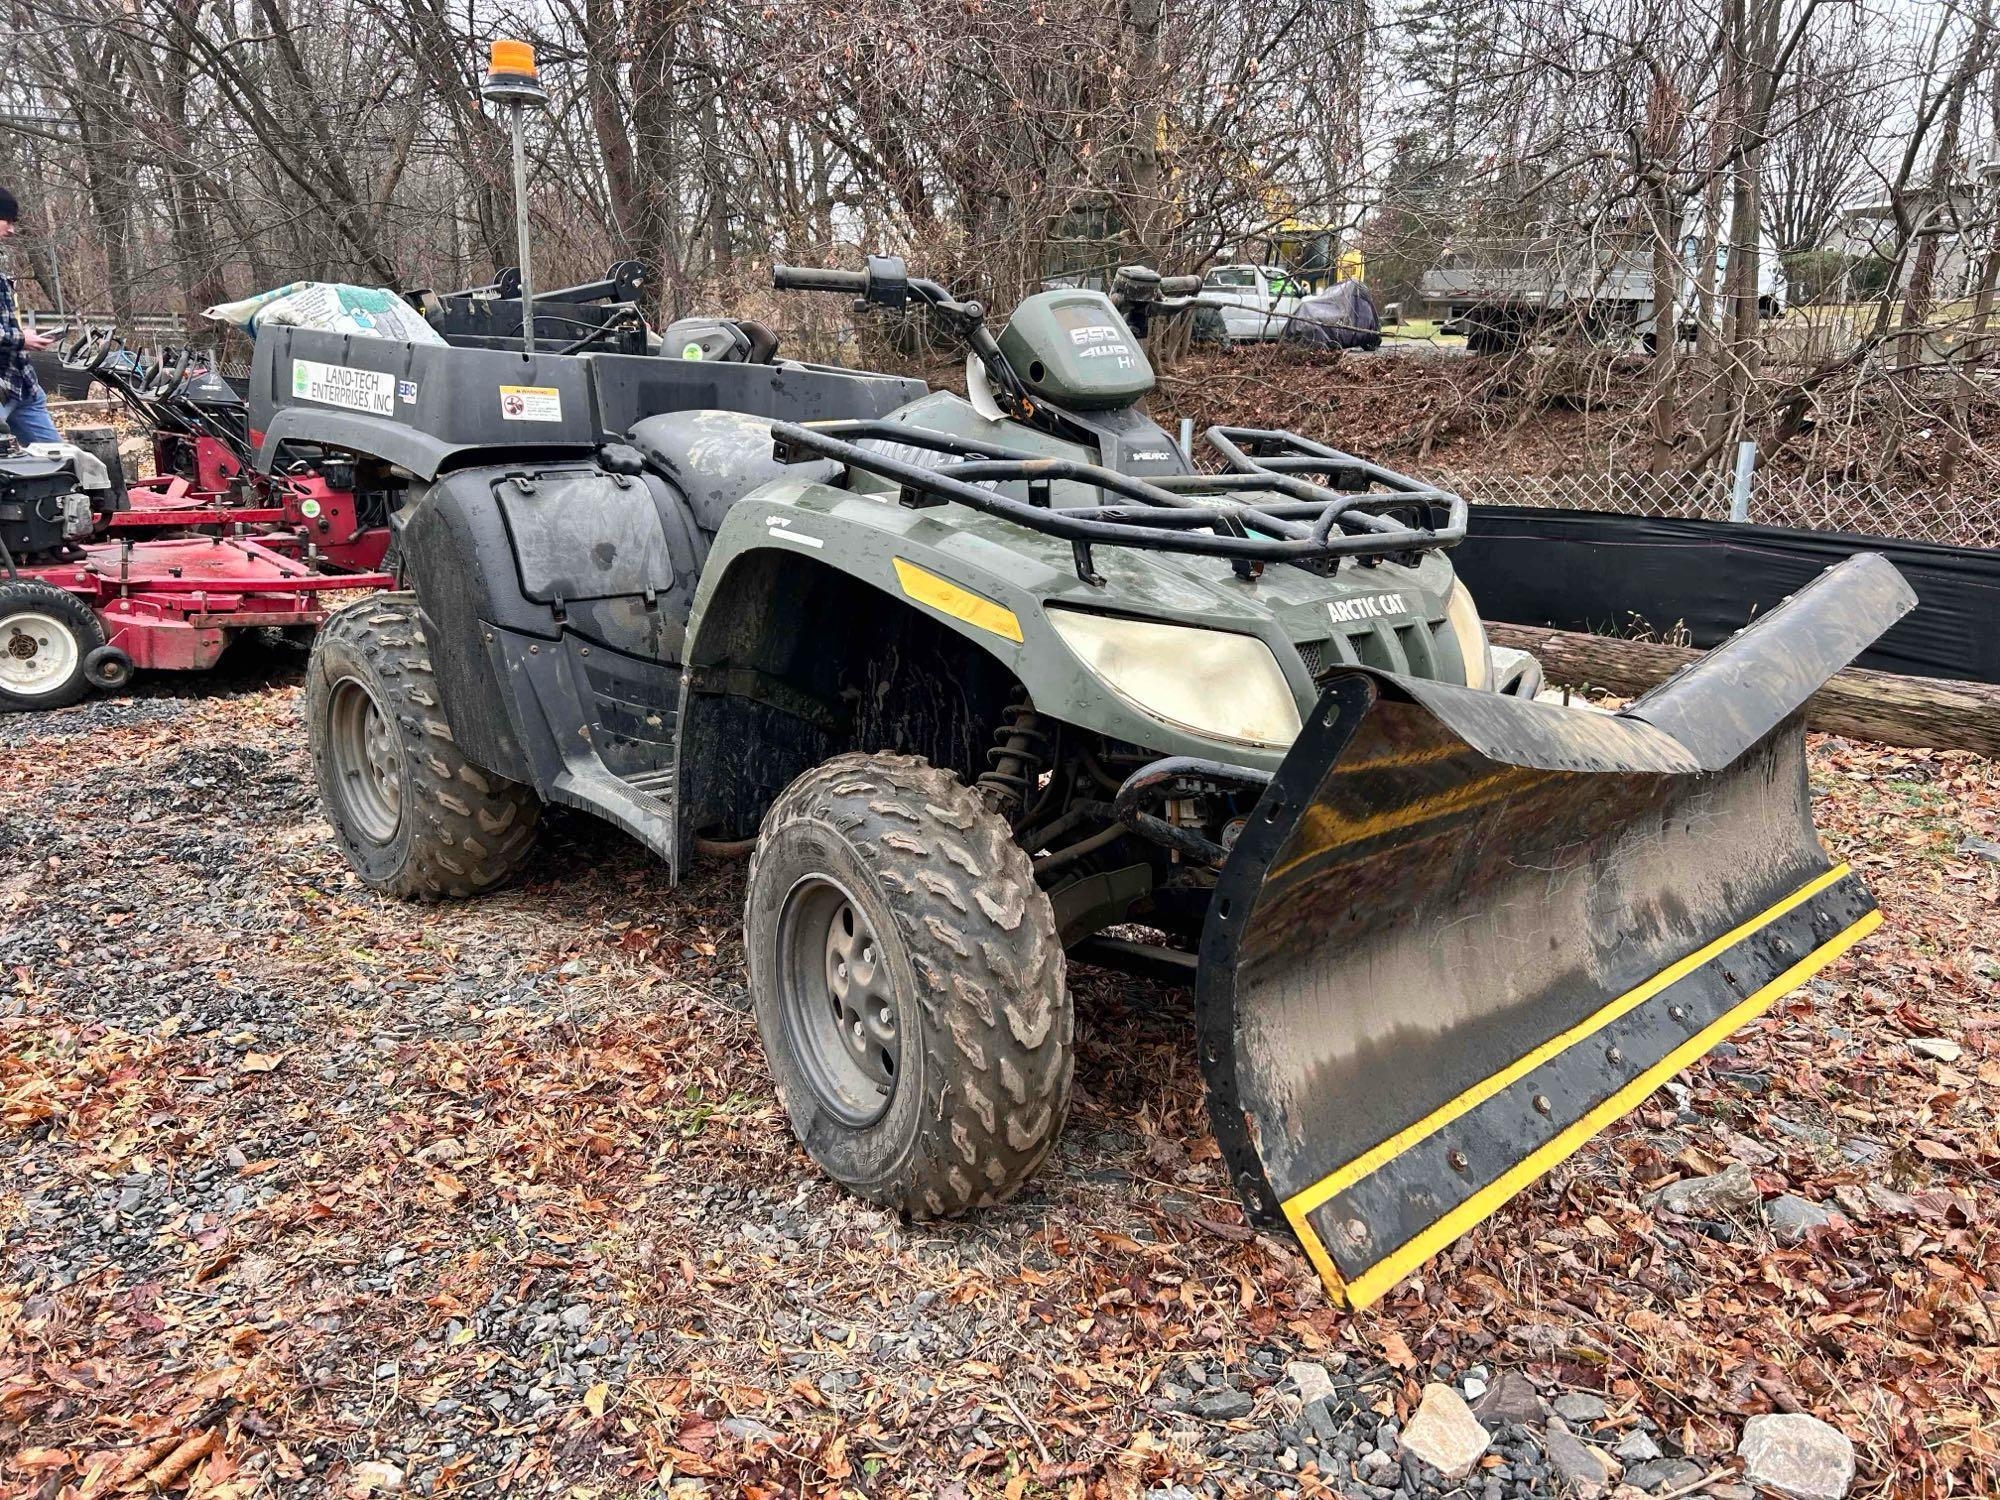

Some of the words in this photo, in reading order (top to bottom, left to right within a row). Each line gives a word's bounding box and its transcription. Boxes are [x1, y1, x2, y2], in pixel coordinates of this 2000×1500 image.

[1070, 326, 1120, 345] 650
[1079, 344, 1129, 358] 4WD
[325, 367, 380, 391] LAND-TECH
[311, 382, 371, 410] ENTERPRISES,
[373, 394, 393, 412] INC.
[397, 383, 416, 397] EBC
[1326, 596, 1381, 623] ARCTIC
[1378, 593, 1407, 615] CAT
